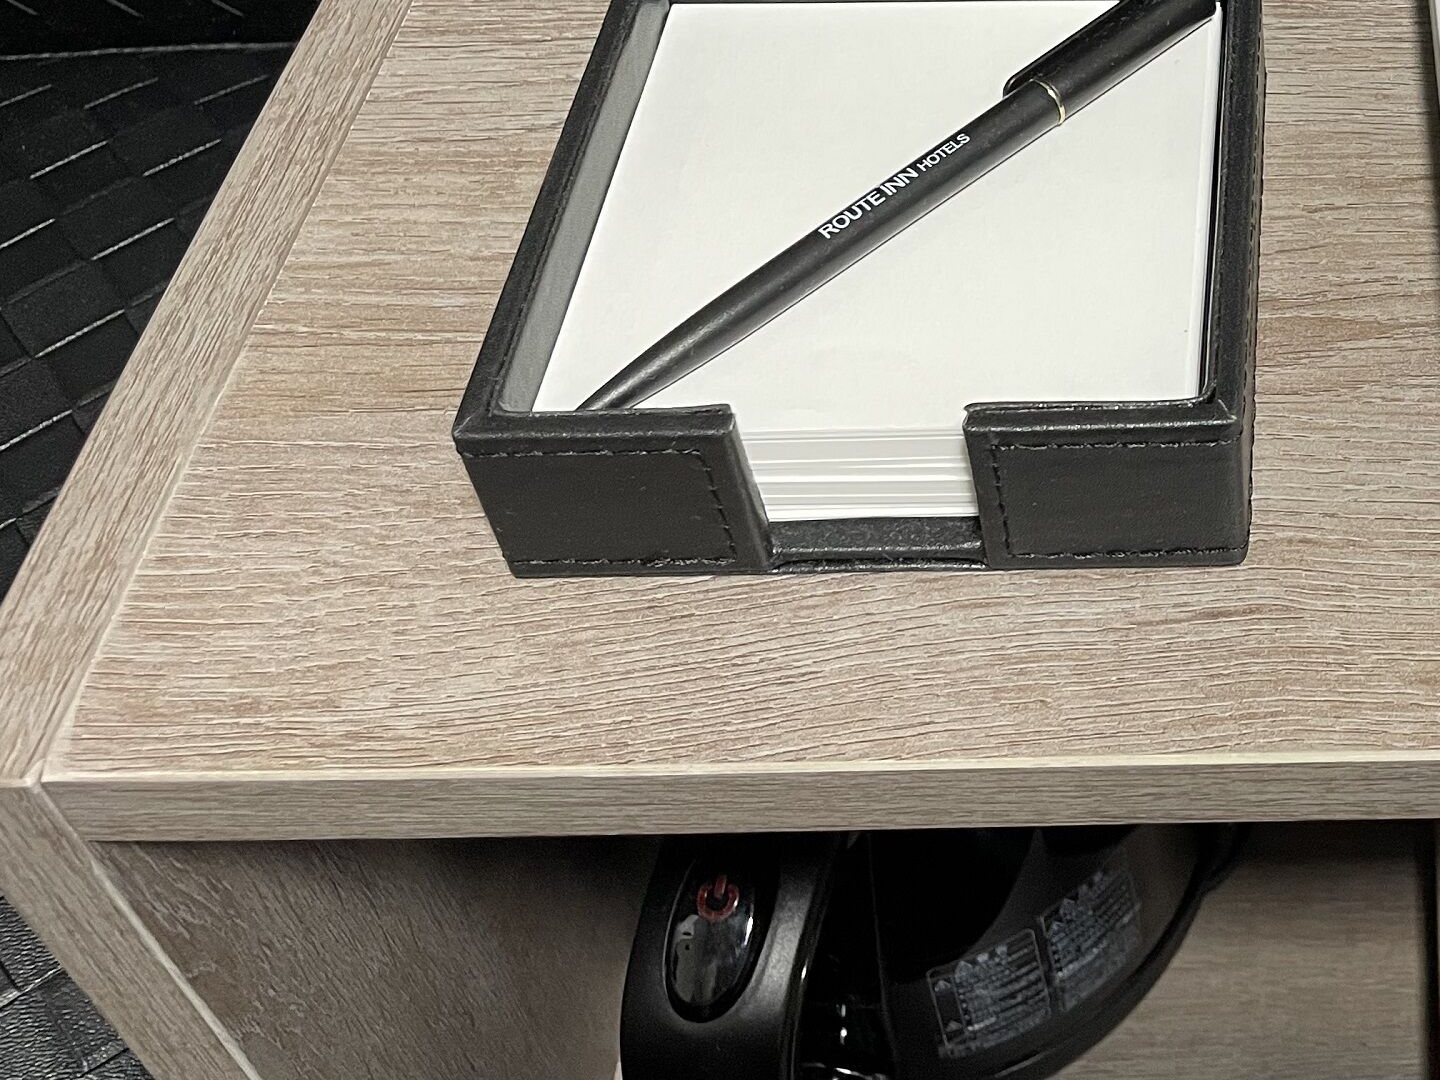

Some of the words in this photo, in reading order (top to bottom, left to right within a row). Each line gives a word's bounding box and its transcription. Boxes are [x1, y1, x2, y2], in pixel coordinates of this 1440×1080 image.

[818, 190, 886, 239] ROUTE
[880, 167, 919, 196] INN
[916, 133, 971, 172] HOTELS
